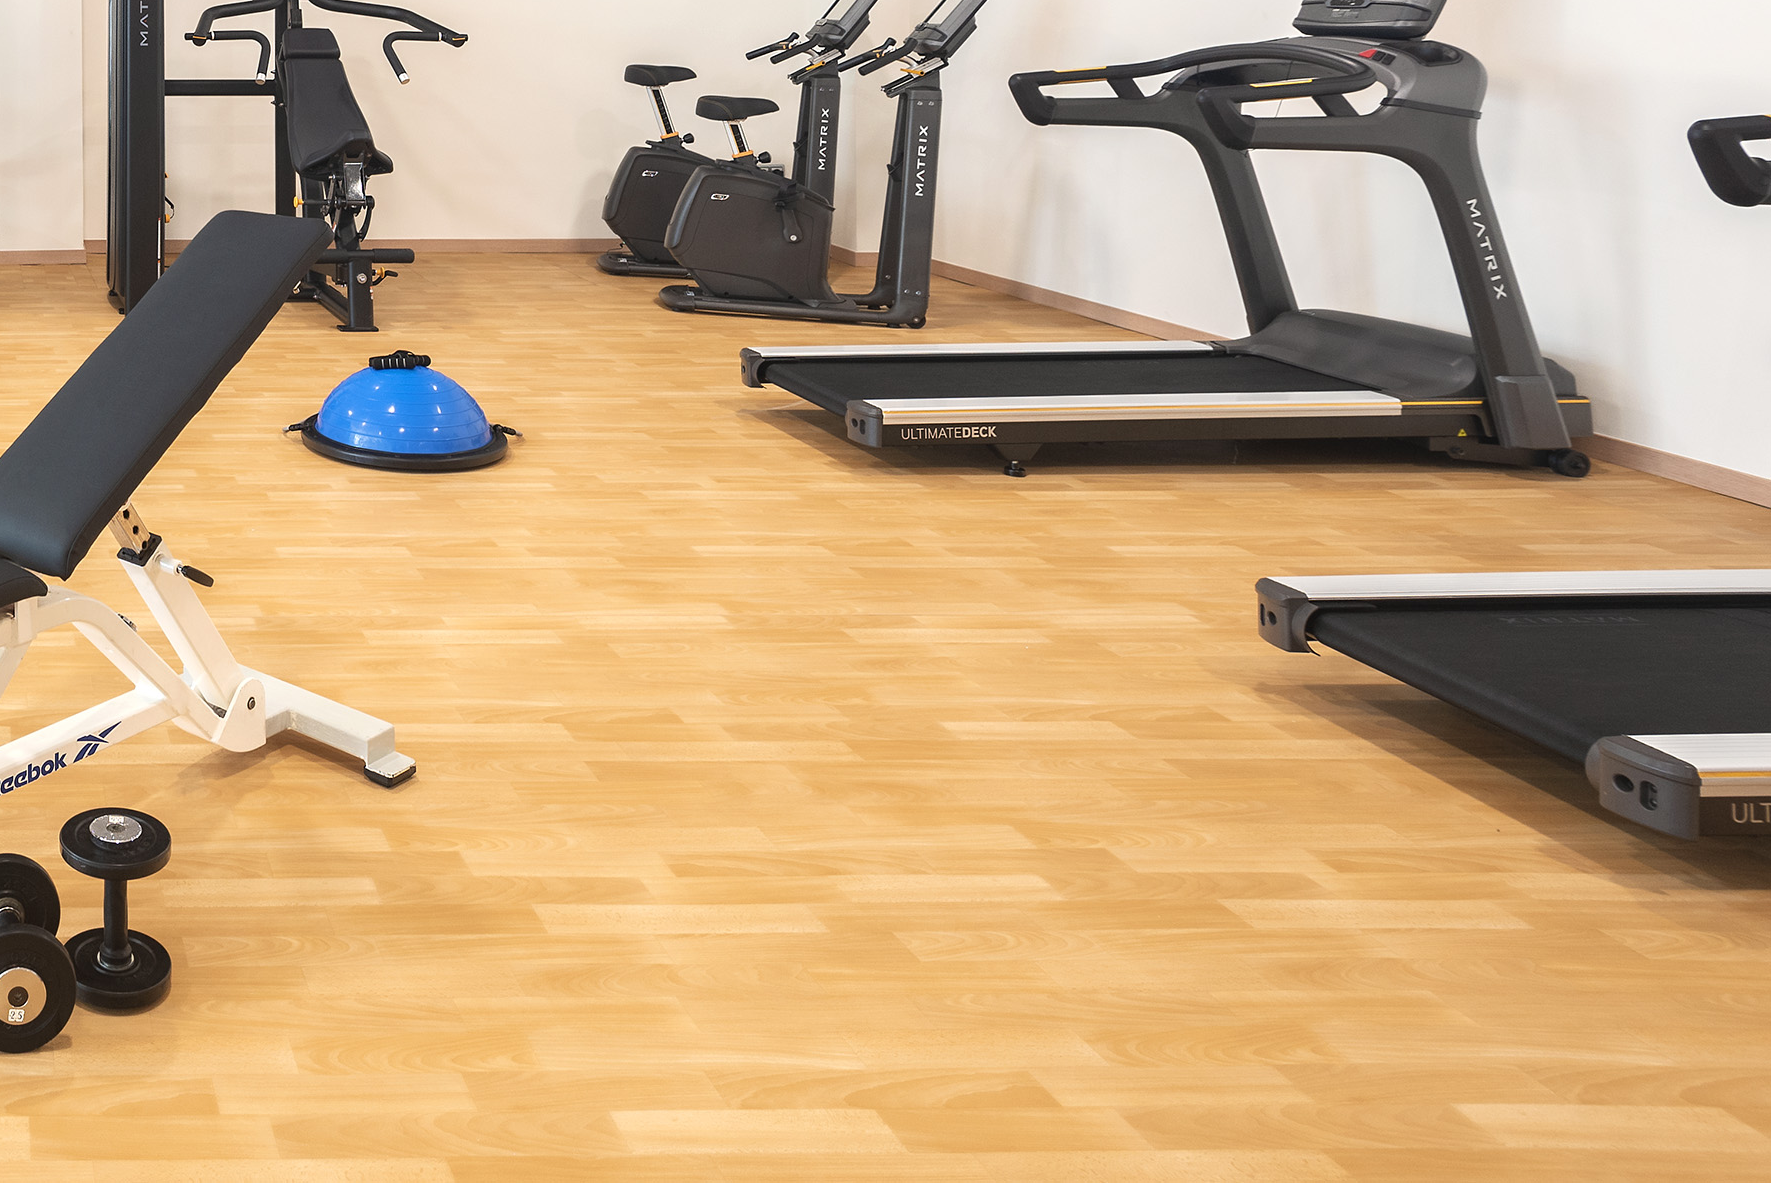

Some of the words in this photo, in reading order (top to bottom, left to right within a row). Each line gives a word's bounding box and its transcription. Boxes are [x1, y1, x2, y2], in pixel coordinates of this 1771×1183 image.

[817, 108, 830, 171] MATRIX
[914, 125, 929, 197] MATRIX
[1466, 198, 1507, 300] MATRIX
[901, 426, 997, 440] ULTIMATEDECK
[1731, 802, 1771, 824] ULT
